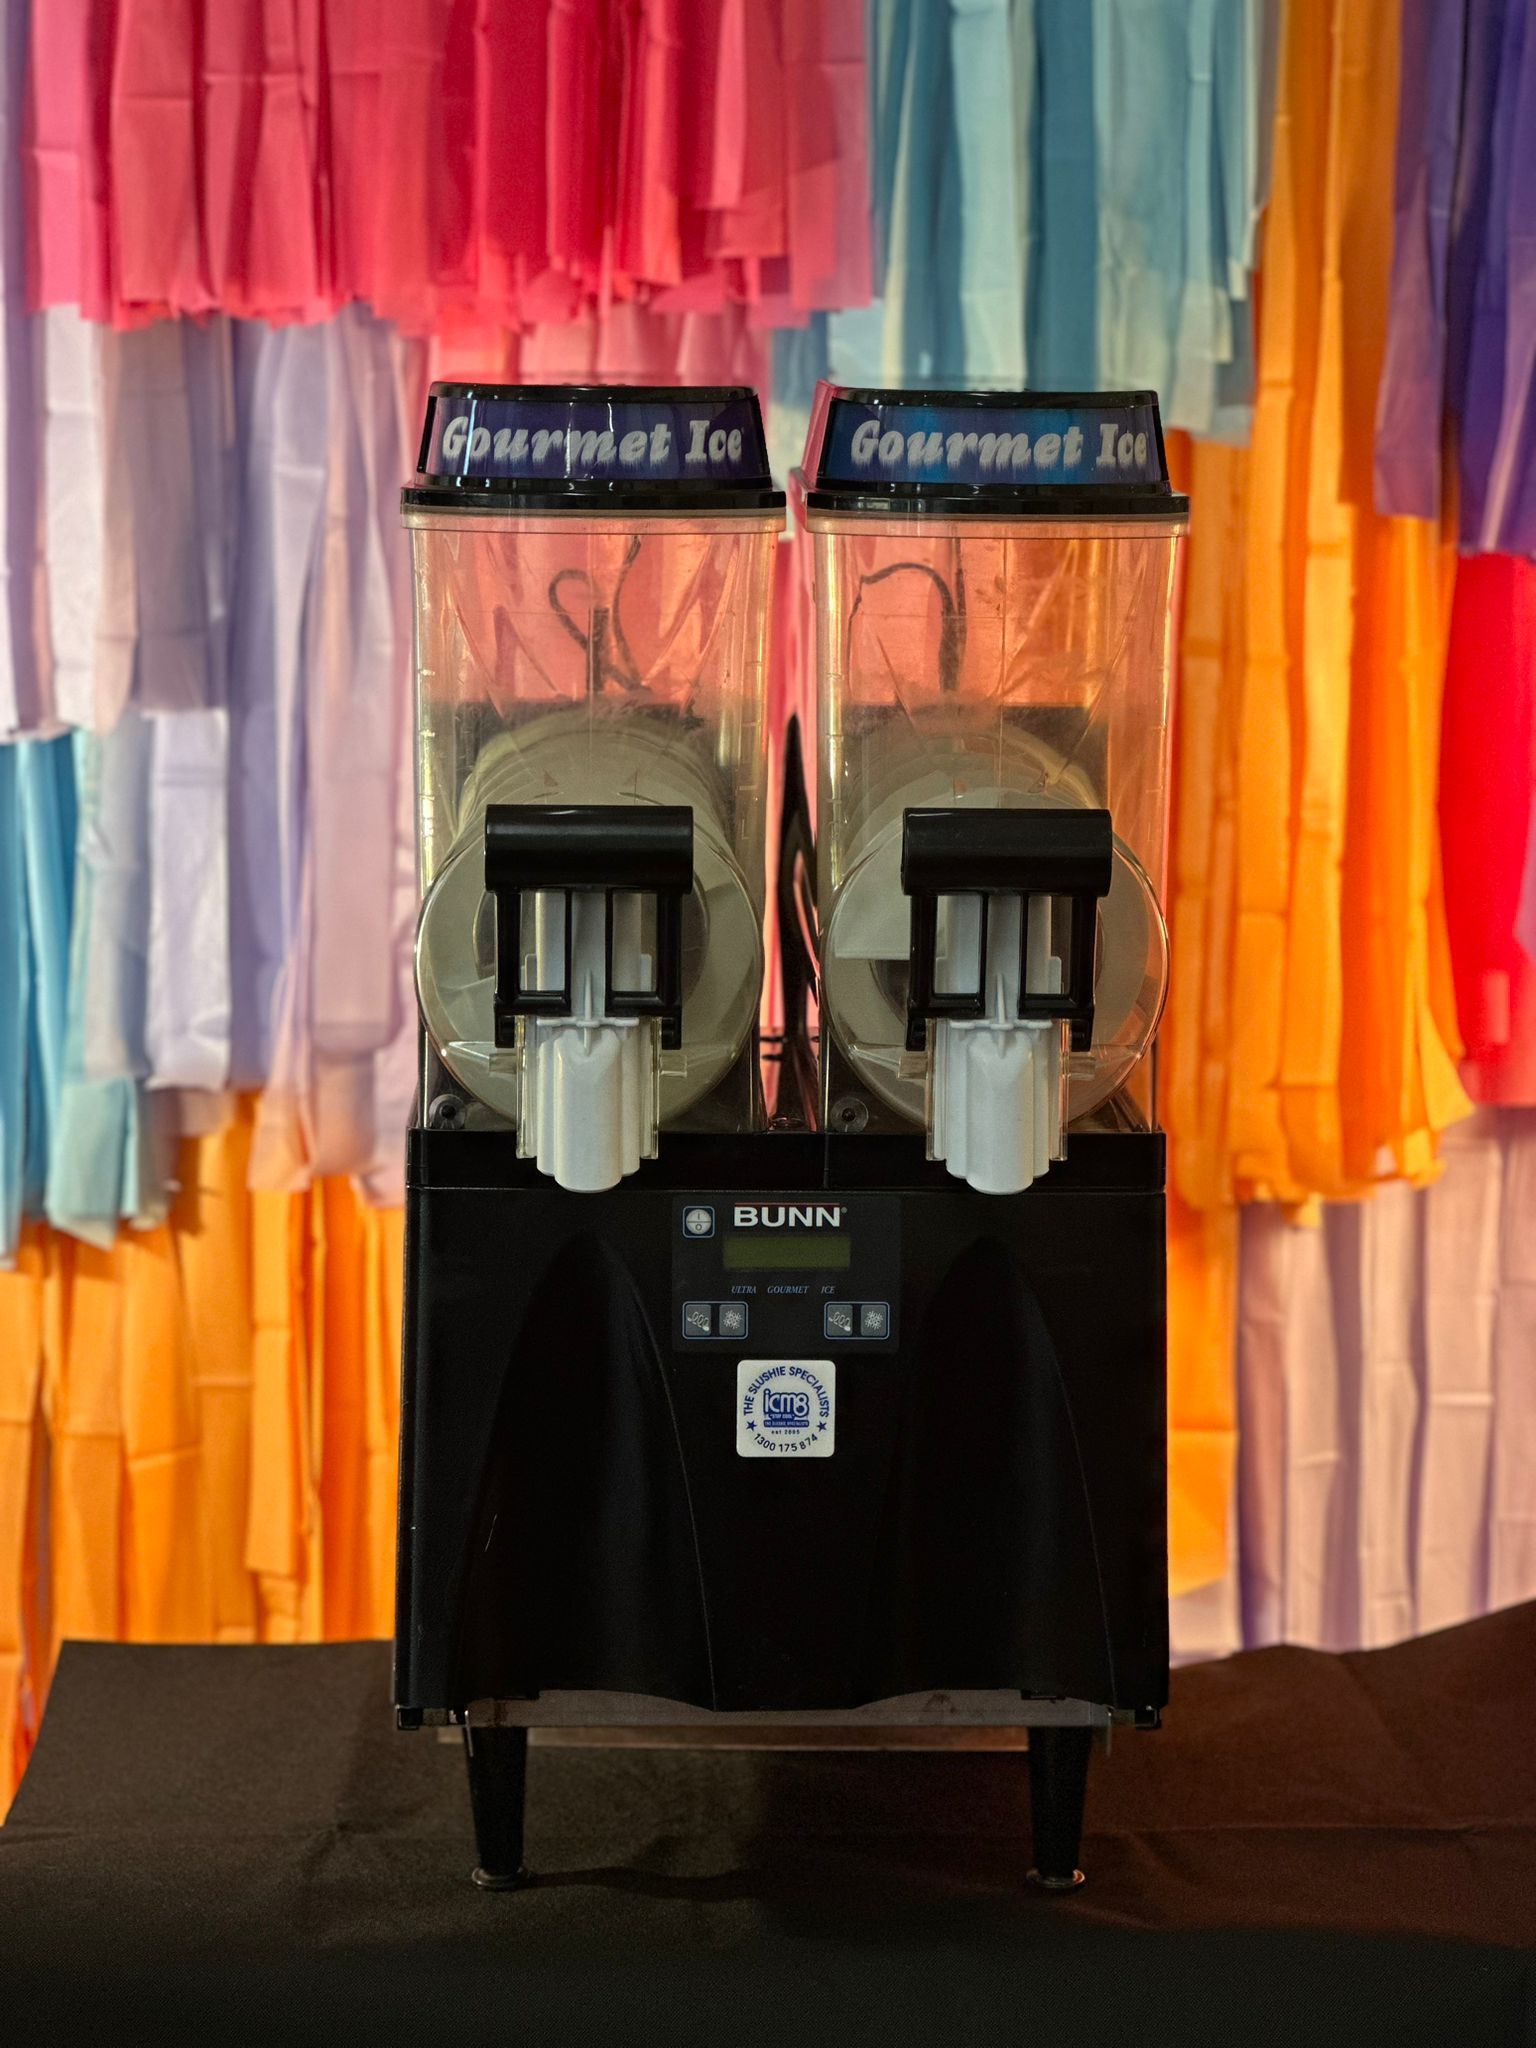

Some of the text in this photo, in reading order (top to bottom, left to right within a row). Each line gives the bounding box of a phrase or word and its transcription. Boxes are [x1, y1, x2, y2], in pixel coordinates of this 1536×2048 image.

[442, 416, 744, 465] Gourmet Ice
[850, 419, 1148, 469] Gourmet Ice
[731, 1286, 836, 1294] ULTRA GOURMET ICE
[743, 1366, 830, 1418] THE SLUSHIE SPECIALISTS
[753, 1433, 818, 1453] 1300 175 874
